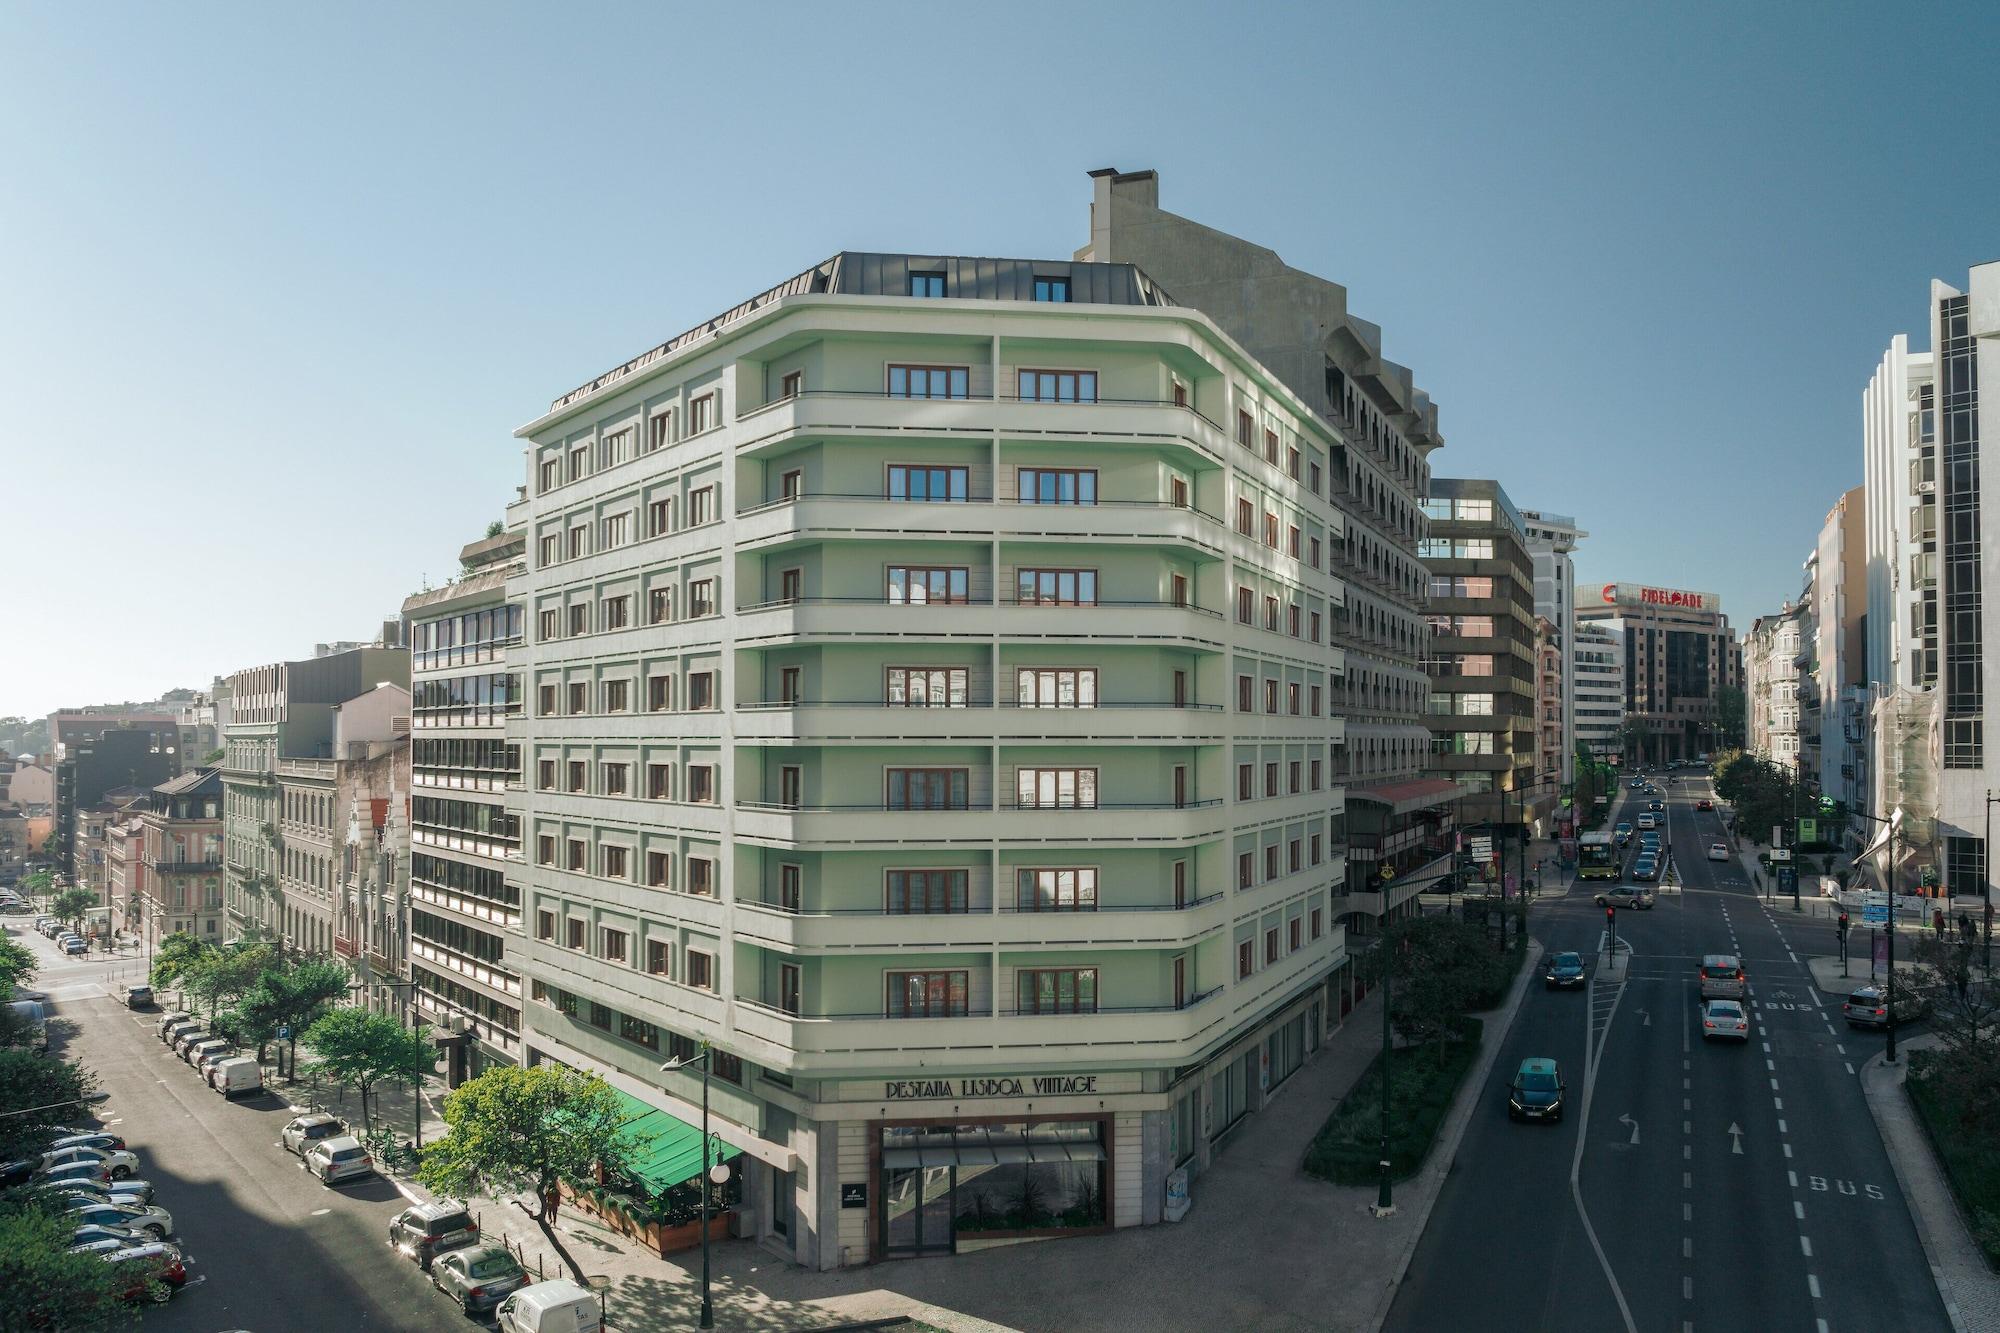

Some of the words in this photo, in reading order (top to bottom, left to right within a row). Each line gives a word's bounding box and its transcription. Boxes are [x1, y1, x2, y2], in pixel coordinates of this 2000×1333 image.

[1765, 1002, 1812, 1011] BUS
[886, 1081, 953, 1098] PESTANA
[962, 1078, 1024, 1096] LISBOA
[1033, 1076, 1097, 1094] VINTAGE
[1808, 1175, 1884, 1199] BUS
